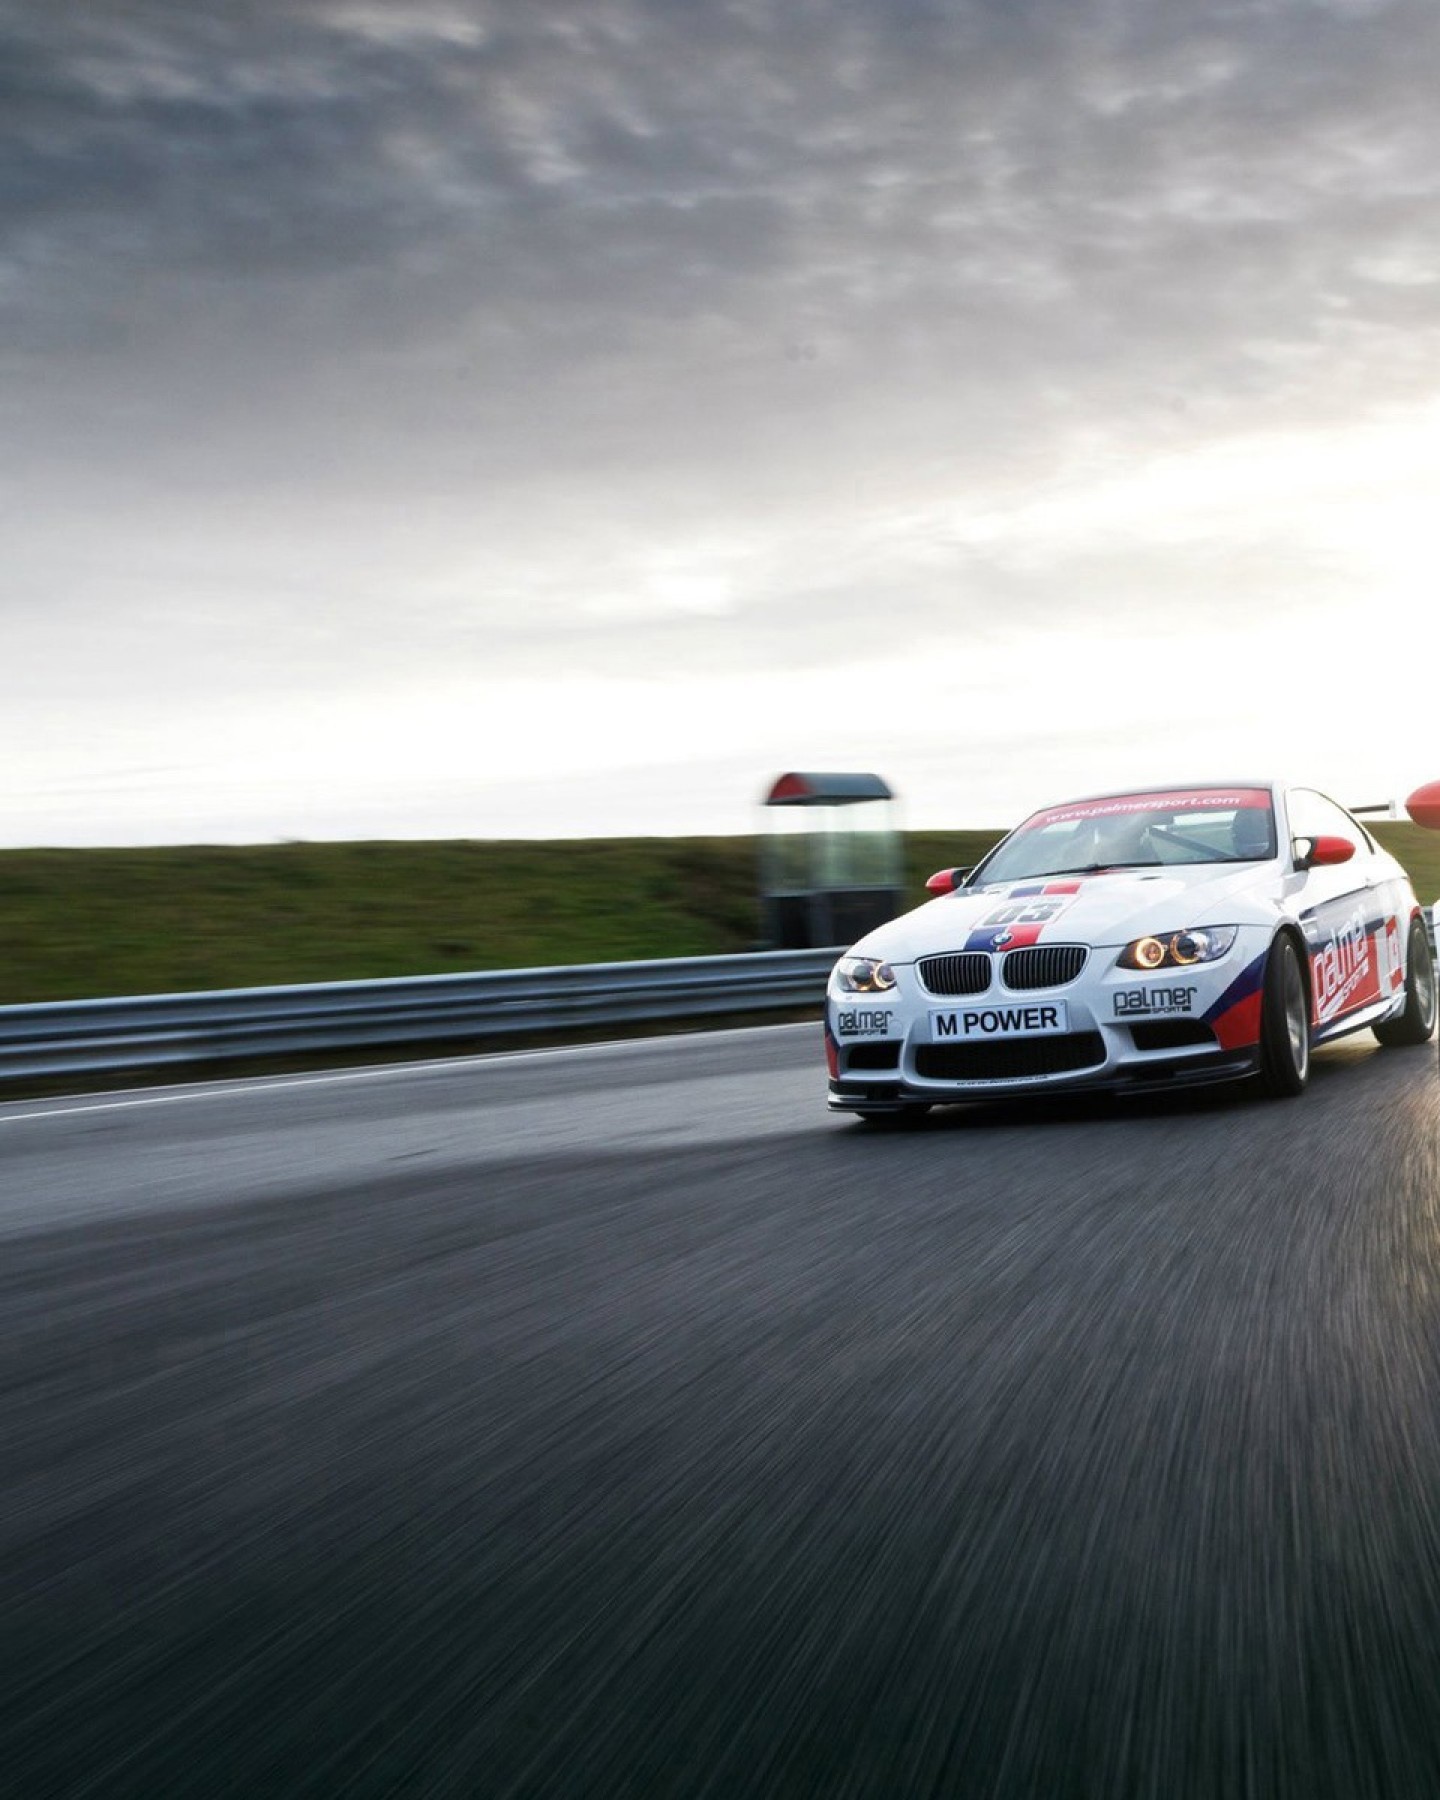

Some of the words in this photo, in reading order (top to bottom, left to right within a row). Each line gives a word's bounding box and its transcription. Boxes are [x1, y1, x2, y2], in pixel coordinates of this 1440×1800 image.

[1046, 796, 1241, 823] www.palmersport.com
[1113, 986, 1198, 1017] palmer
[838, 1008, 893, 1036] palmer
[936, 1013, 958, 1036] M
[962, 1006, 1059, 1034] POWER
